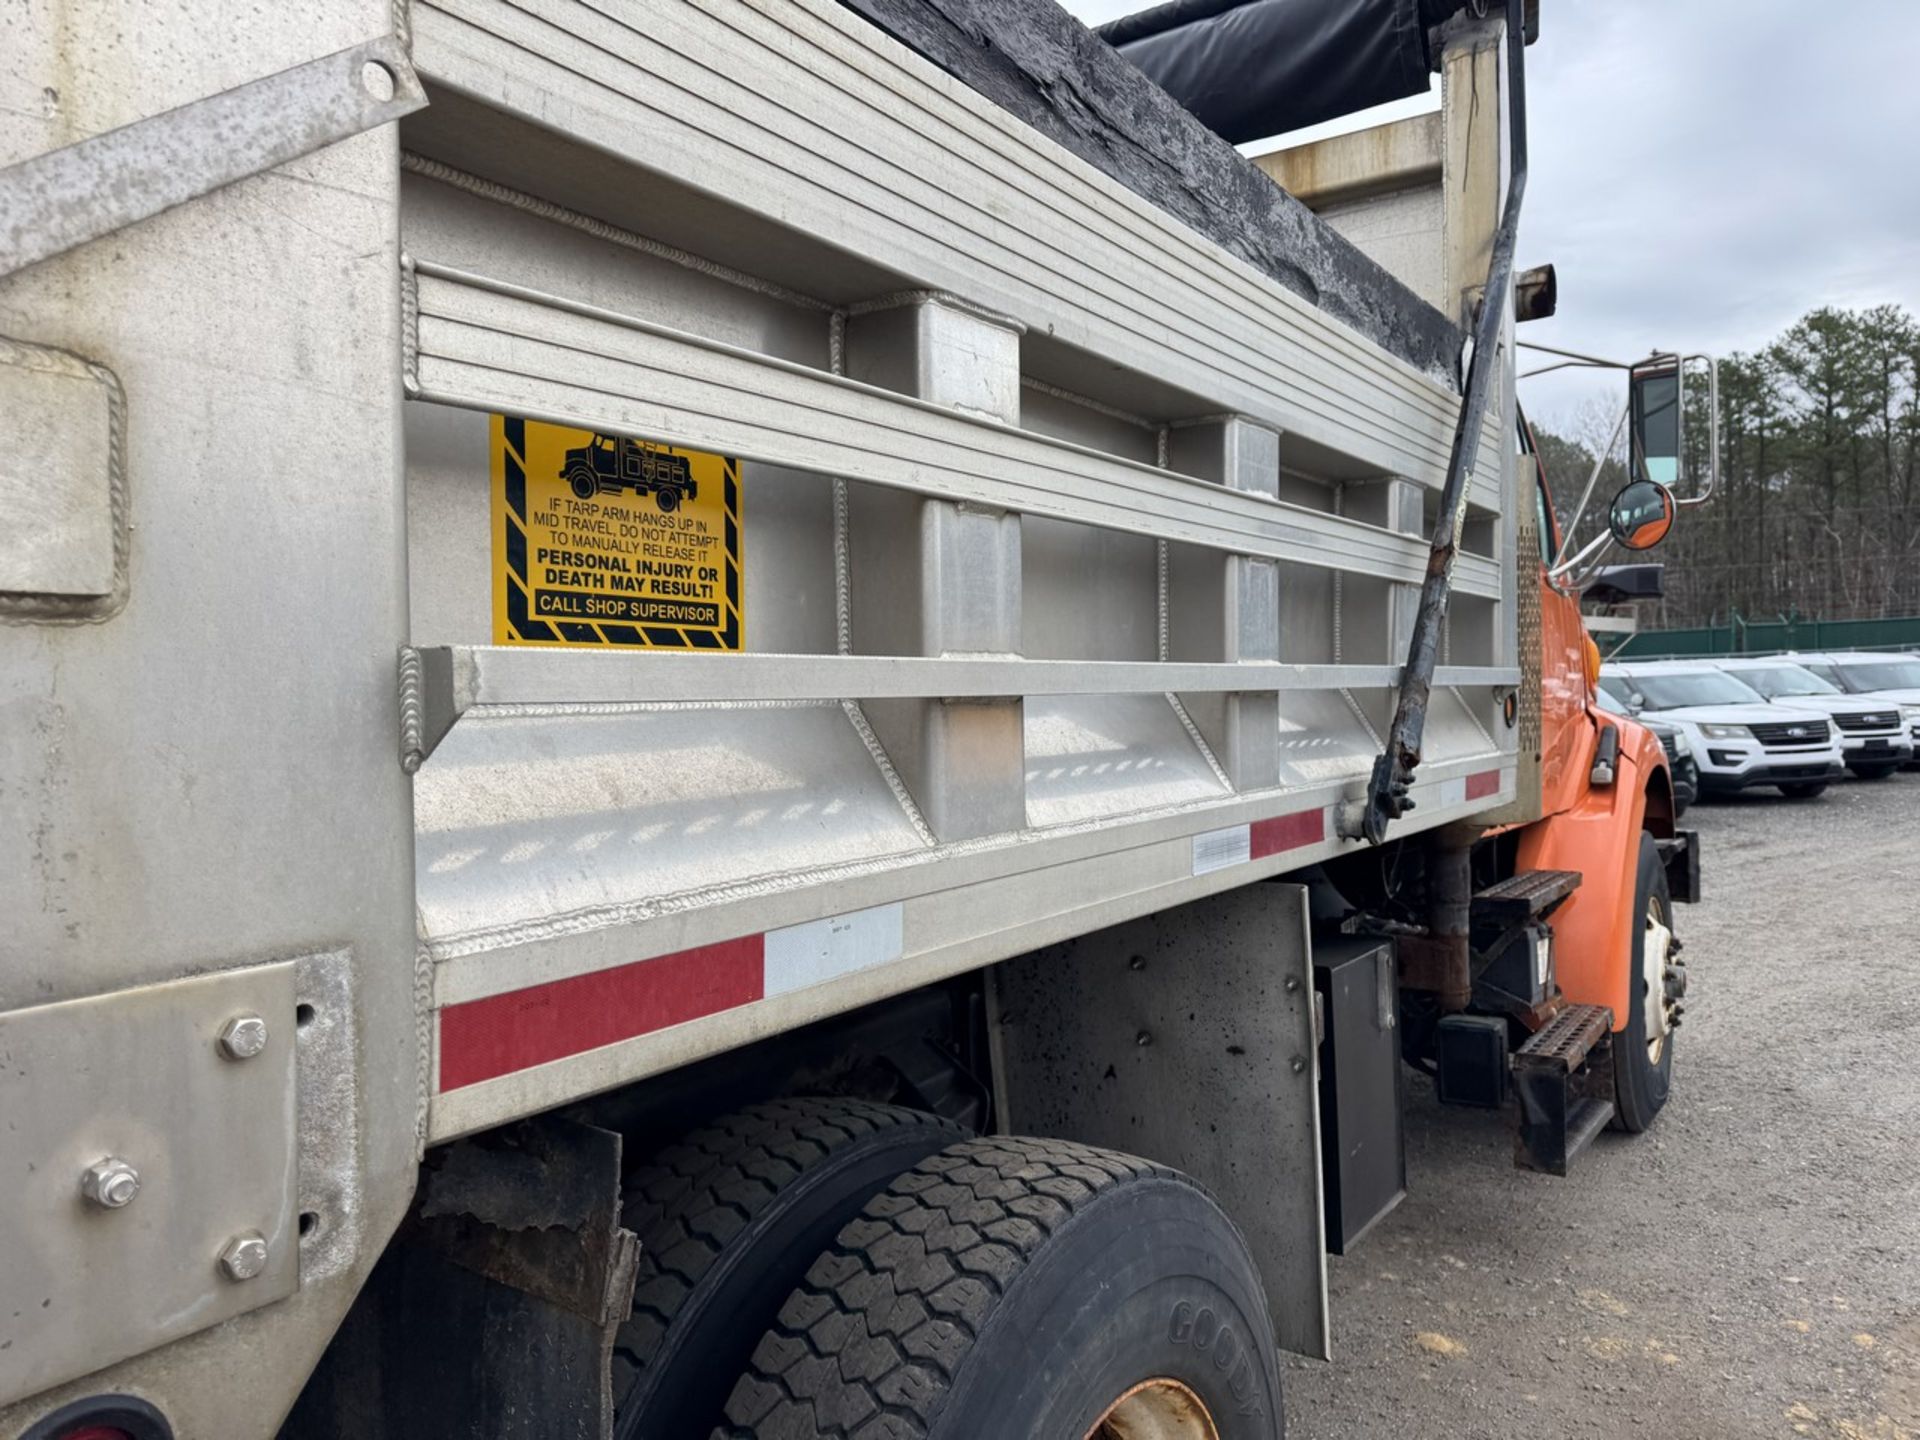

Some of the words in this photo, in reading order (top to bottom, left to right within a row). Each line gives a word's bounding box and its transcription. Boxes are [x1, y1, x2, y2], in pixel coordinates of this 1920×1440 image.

[534, 512, 558, 527] MID
[563, 516, 616, 537] TRAVEL,
[620, 525, 638, 539] DO
[641, 528, 666, 541] NOT
[669, 531, 719, 549] ATTEMPT
[550, 498, 561, 511] IF
[566, 500, 599, 516] TARP
[603, 506, 630, 522] ARM
[633, 511, 675, 528] HANGS
[678, 518, 694, 530] UP
[697, 521, 707, 533] IN
[550, 531, 567, 545] TO
[573, 535, 639, 554] MANUALLY
[644, 544, 695, 560] RELEASE
[698, 551, 707, 562] IT
[538, 549, 630, 573] PERSONAL
[637, 560, 692, 579] INJURY
[698, 568, 717, 582] OR
[546, 569, 604, 588] DEATH
[610, 576, 645, 593] MAY
[651, 580, 713, 598] RESULT!
[541, 596, 581, 613] CALL
[586, 598, 626, 615] SHOP
[630, 603, 715, 622] SUPERVISOR
